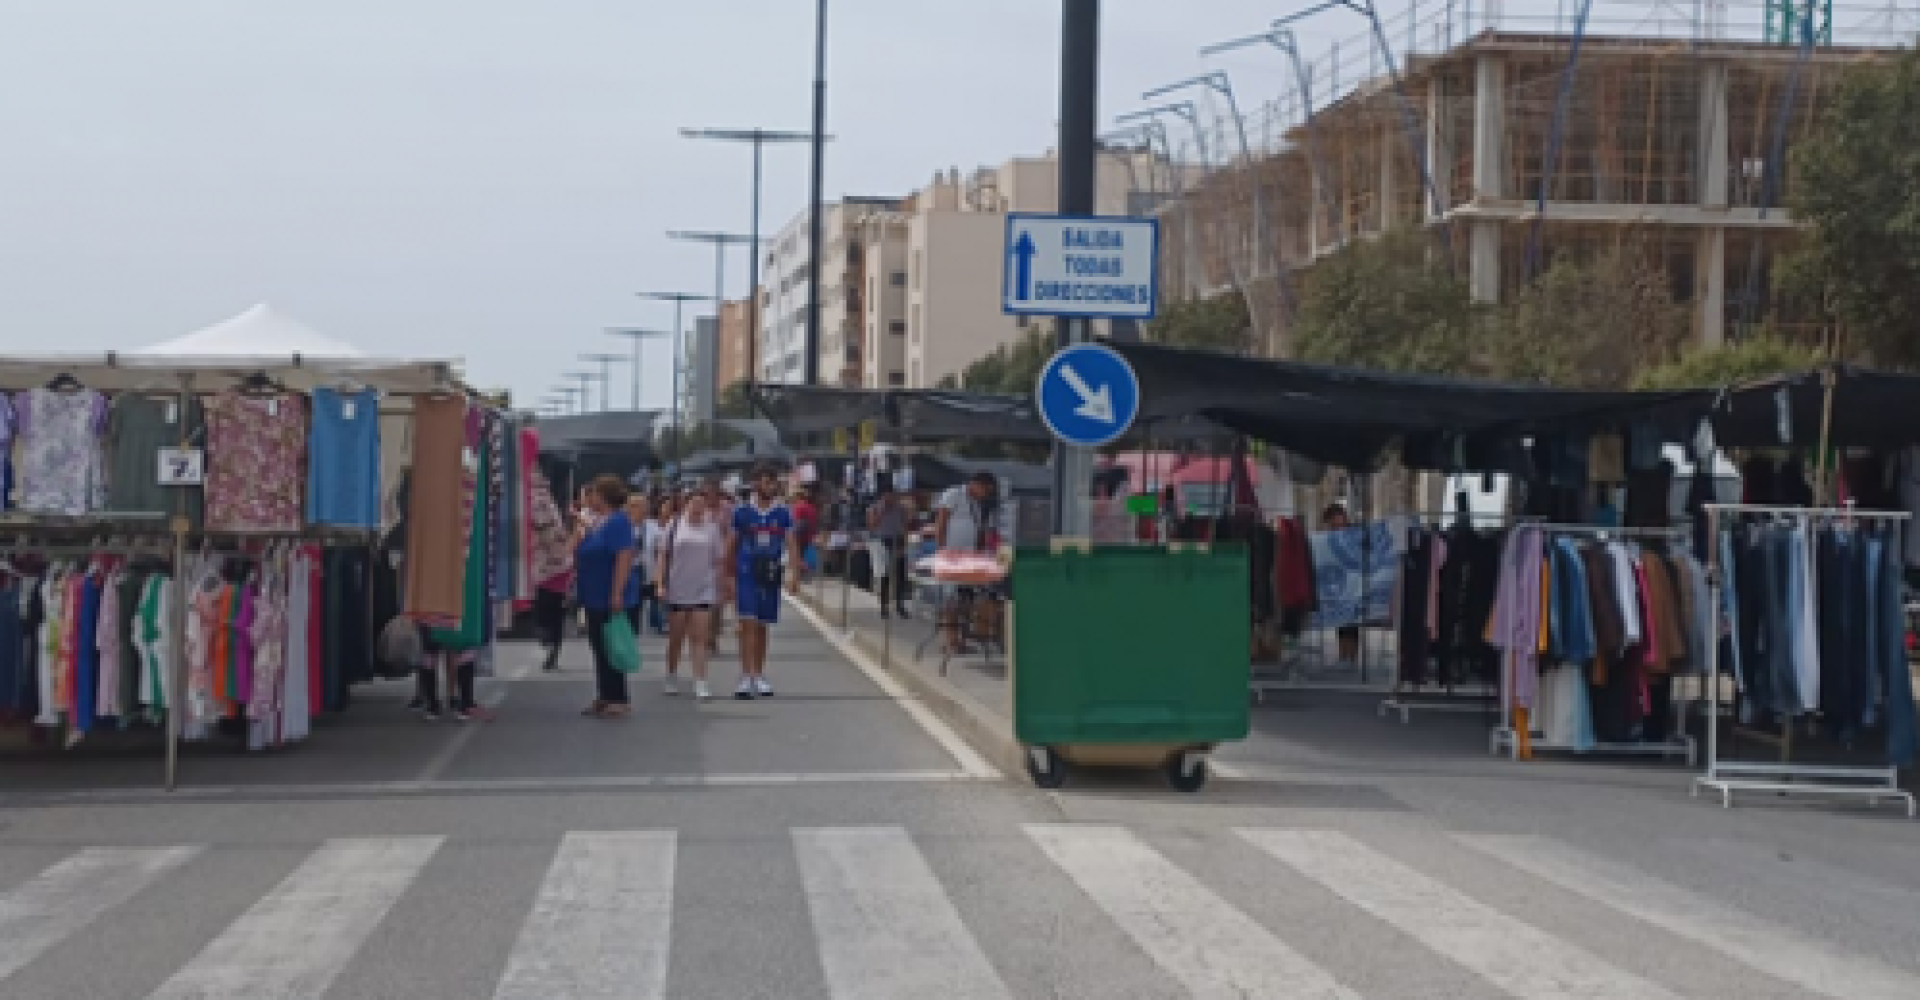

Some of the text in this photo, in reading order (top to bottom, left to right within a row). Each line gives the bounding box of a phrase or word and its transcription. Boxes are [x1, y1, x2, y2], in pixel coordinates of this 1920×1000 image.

[1062, 228, 1122, 249] SALIDA
[1064, 255, 1122, 276] TODAS
[1035, 281, 1149, 304] DIRECCIONES
